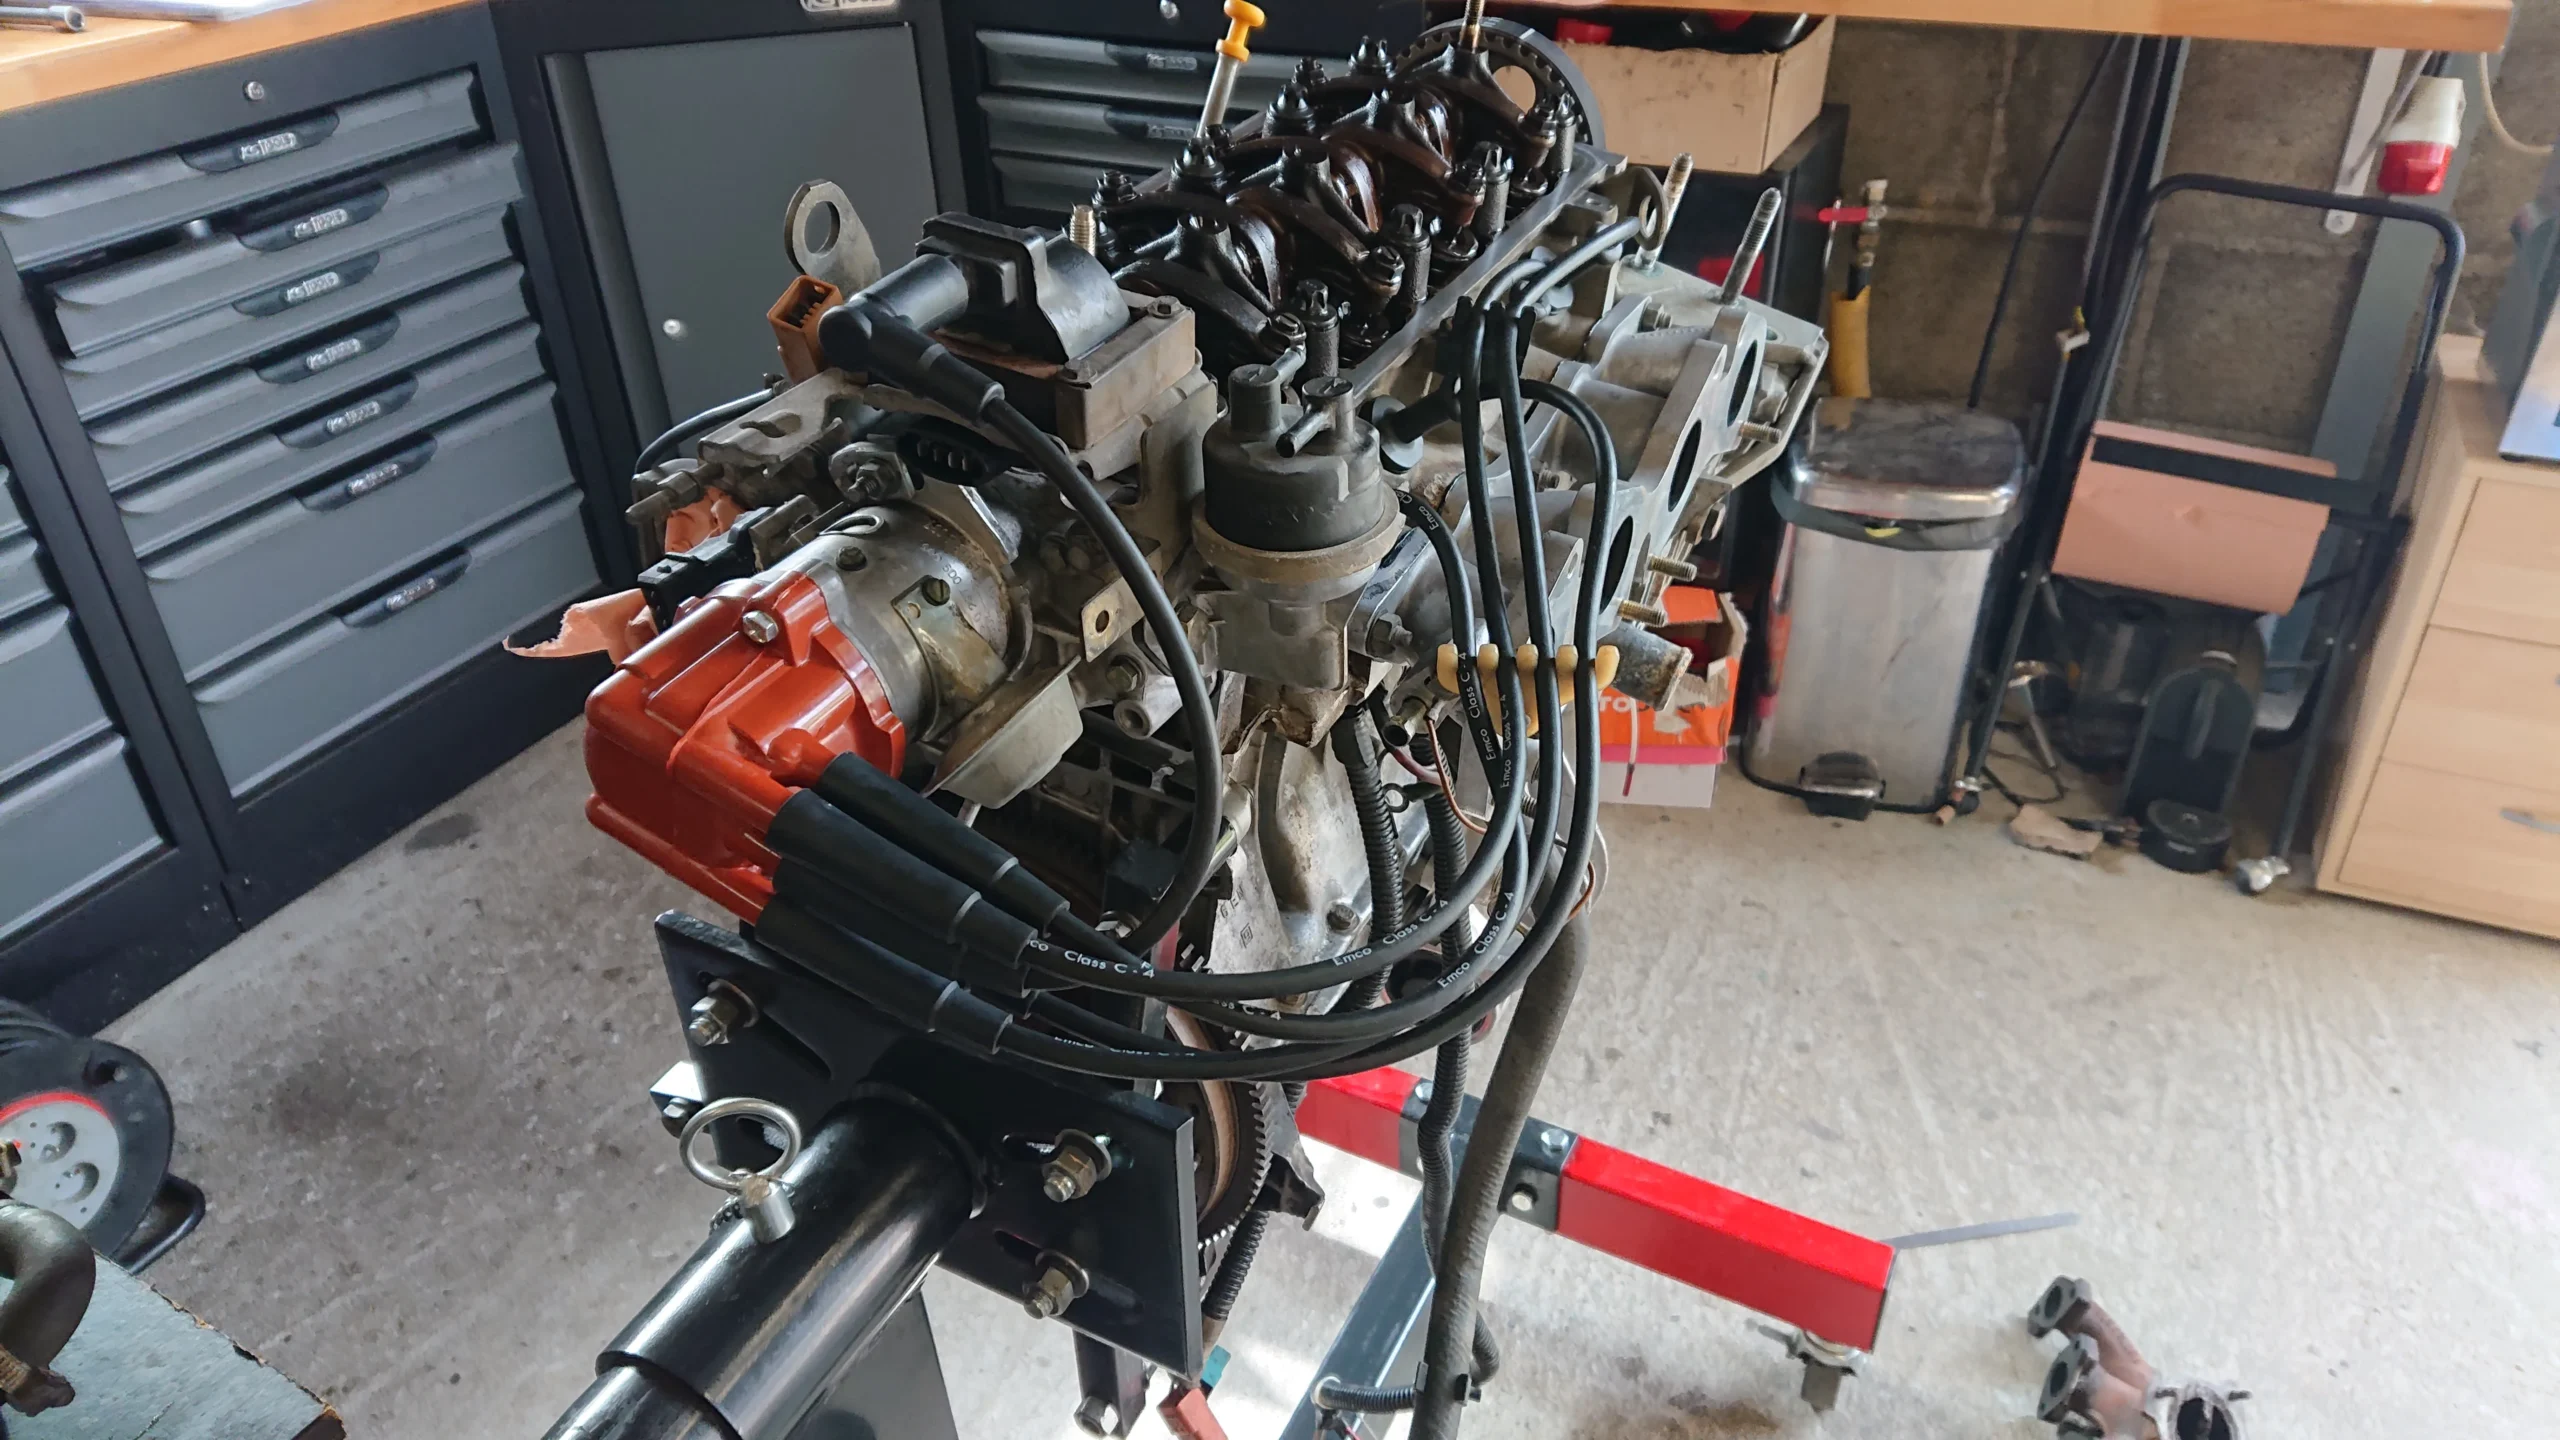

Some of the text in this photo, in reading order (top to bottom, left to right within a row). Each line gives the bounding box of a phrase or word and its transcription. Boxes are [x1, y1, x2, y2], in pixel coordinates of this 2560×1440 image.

[1418, 505, 1439, 531] Emco
[1466, 686, 1481, 719] Class
[1480, 728, 1496, 761] Emco
[1500, 759, 1512, 788] Emco
[1064, 949, 1107, 970] Class
[1332, 946, 1372, 967] Emco
[1382, 922, 1418, 945] Class
[1436, 961, 1471, 989] Emco
[1474, 922, 1500, 955] Class
